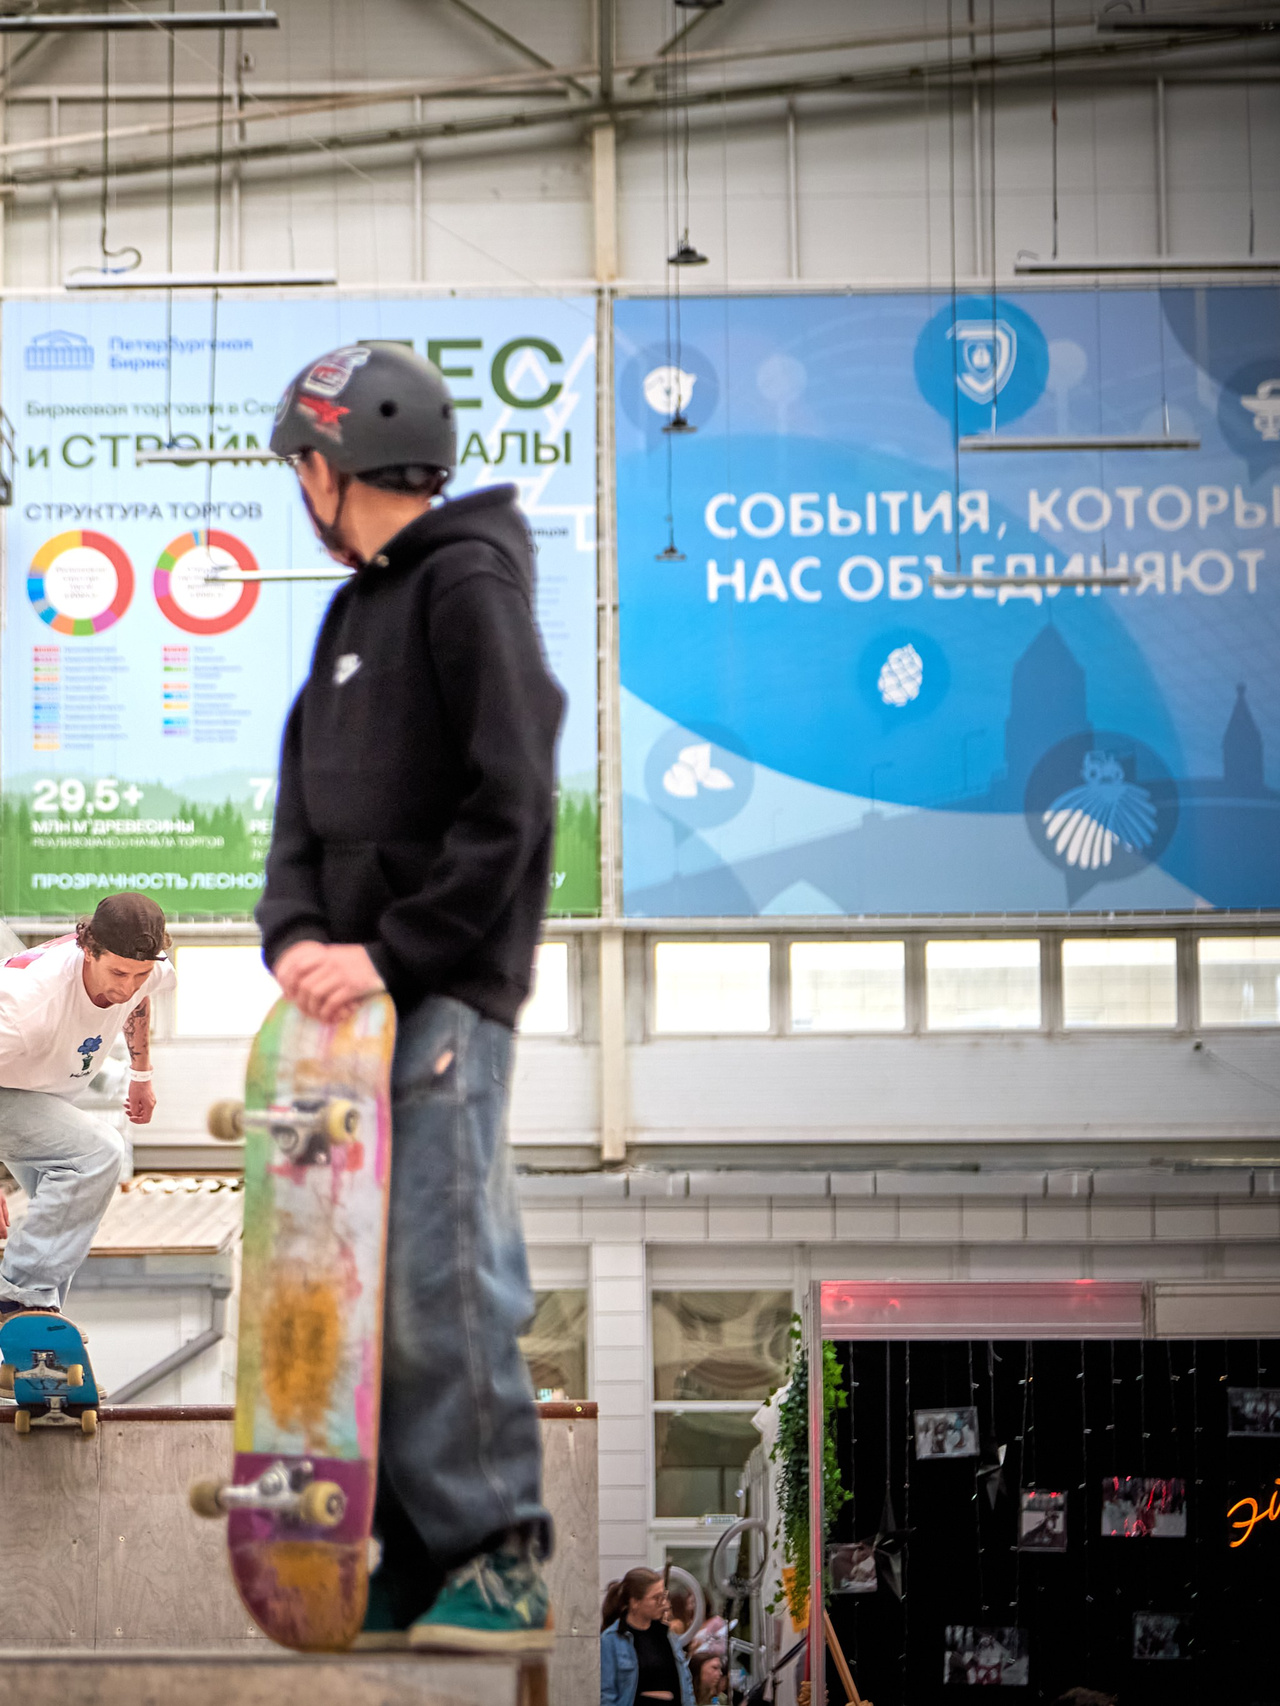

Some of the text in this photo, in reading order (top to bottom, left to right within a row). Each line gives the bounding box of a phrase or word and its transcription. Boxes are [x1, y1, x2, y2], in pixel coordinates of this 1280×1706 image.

[357, 337, 565, 410] ЕС
[24, 502, 263, 521] СТРУКТУРА ТОРГОВ
[704, 489, 1006, 540] СОБЫТИЯ,
[706, 549, 1266, 607] НАС ОБЪЕДИНЯЮТ
[32, 778, 144, 815] 29,5+
[92, 819, 195, 836] ДРЕВЕСИНЫ
[31, 872, 189, 891] ПРОЗРАЧНОСТЬ
